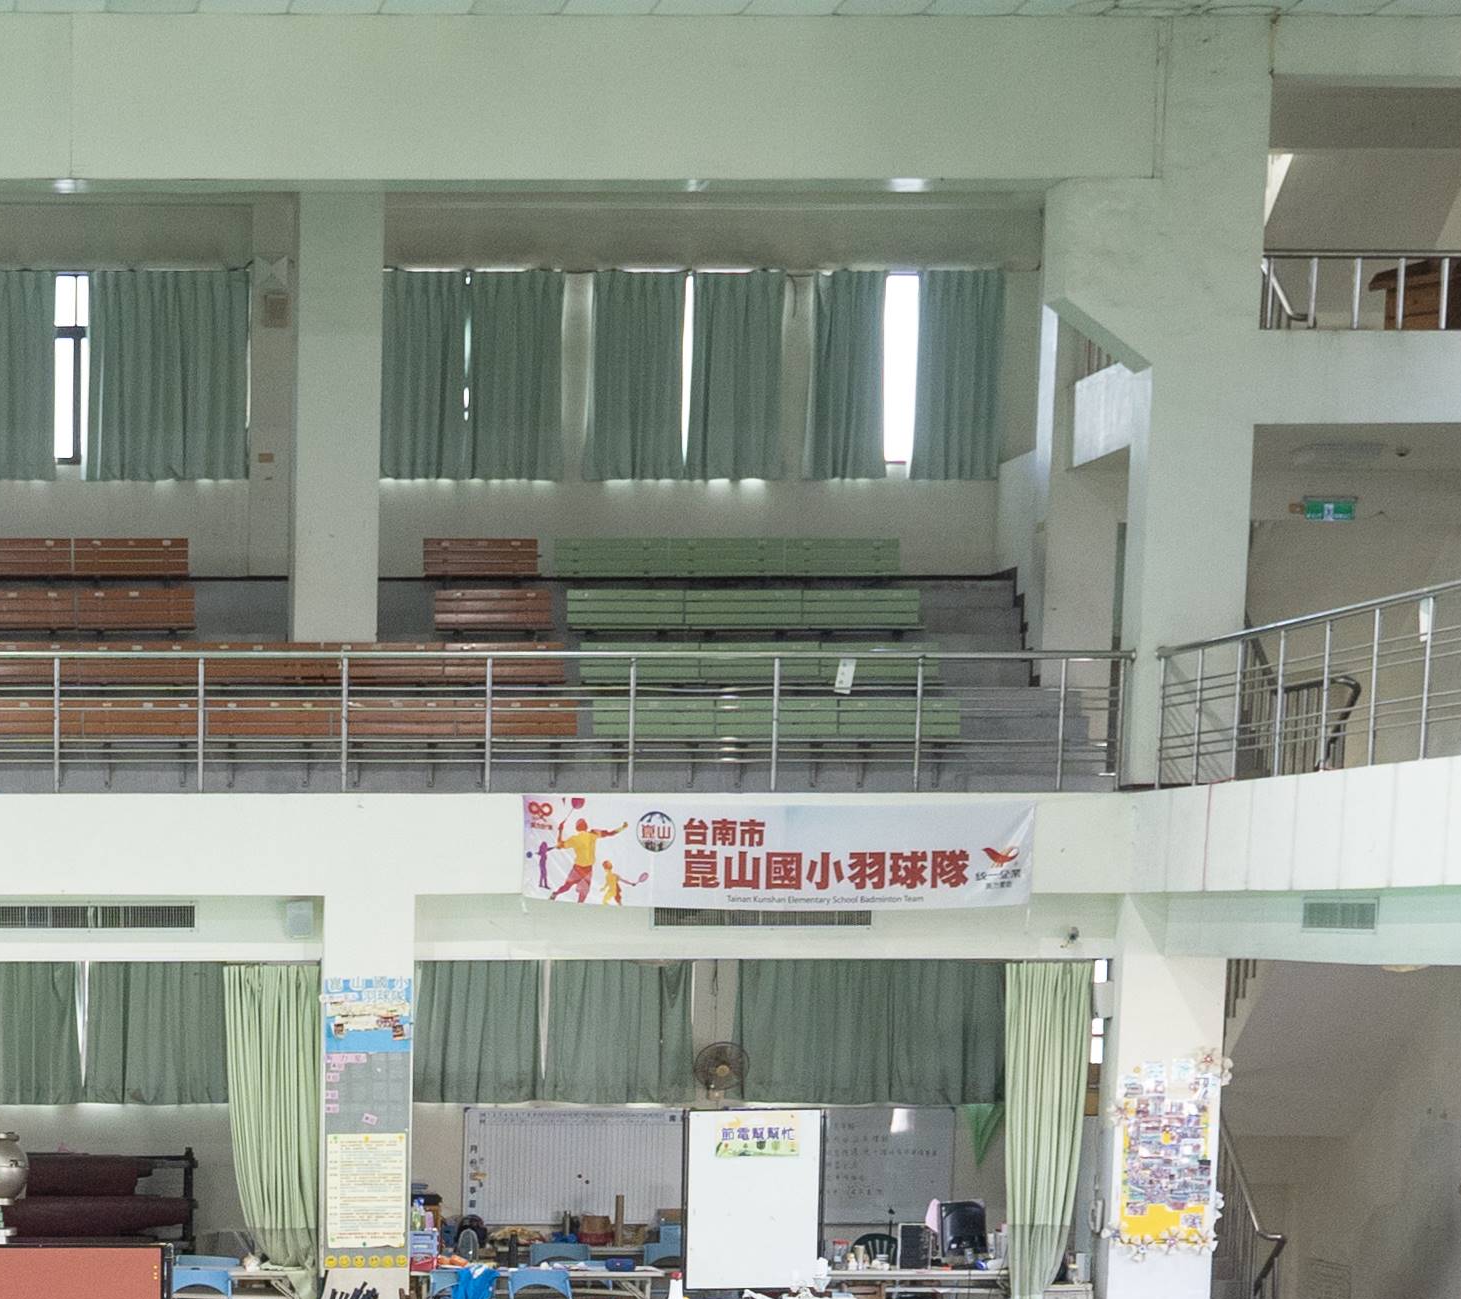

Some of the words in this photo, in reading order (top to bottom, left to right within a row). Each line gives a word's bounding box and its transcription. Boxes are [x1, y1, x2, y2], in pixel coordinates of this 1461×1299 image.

[684, 818, 765, 847] 台南市
[682, 849, 970, 890] 崑山國小羽球隊
[727, 895, 751, 903] Tainan
[753, 895, 786, 904] Kunshan
[787, 895, 831, 905] Elementary
[832, 895, 859, 904] School
[860, 895, 903, 904] Badminton
[904, 895, 924, 903] Team
[721, 1126, 796, 1141] 節電幫幫忙
